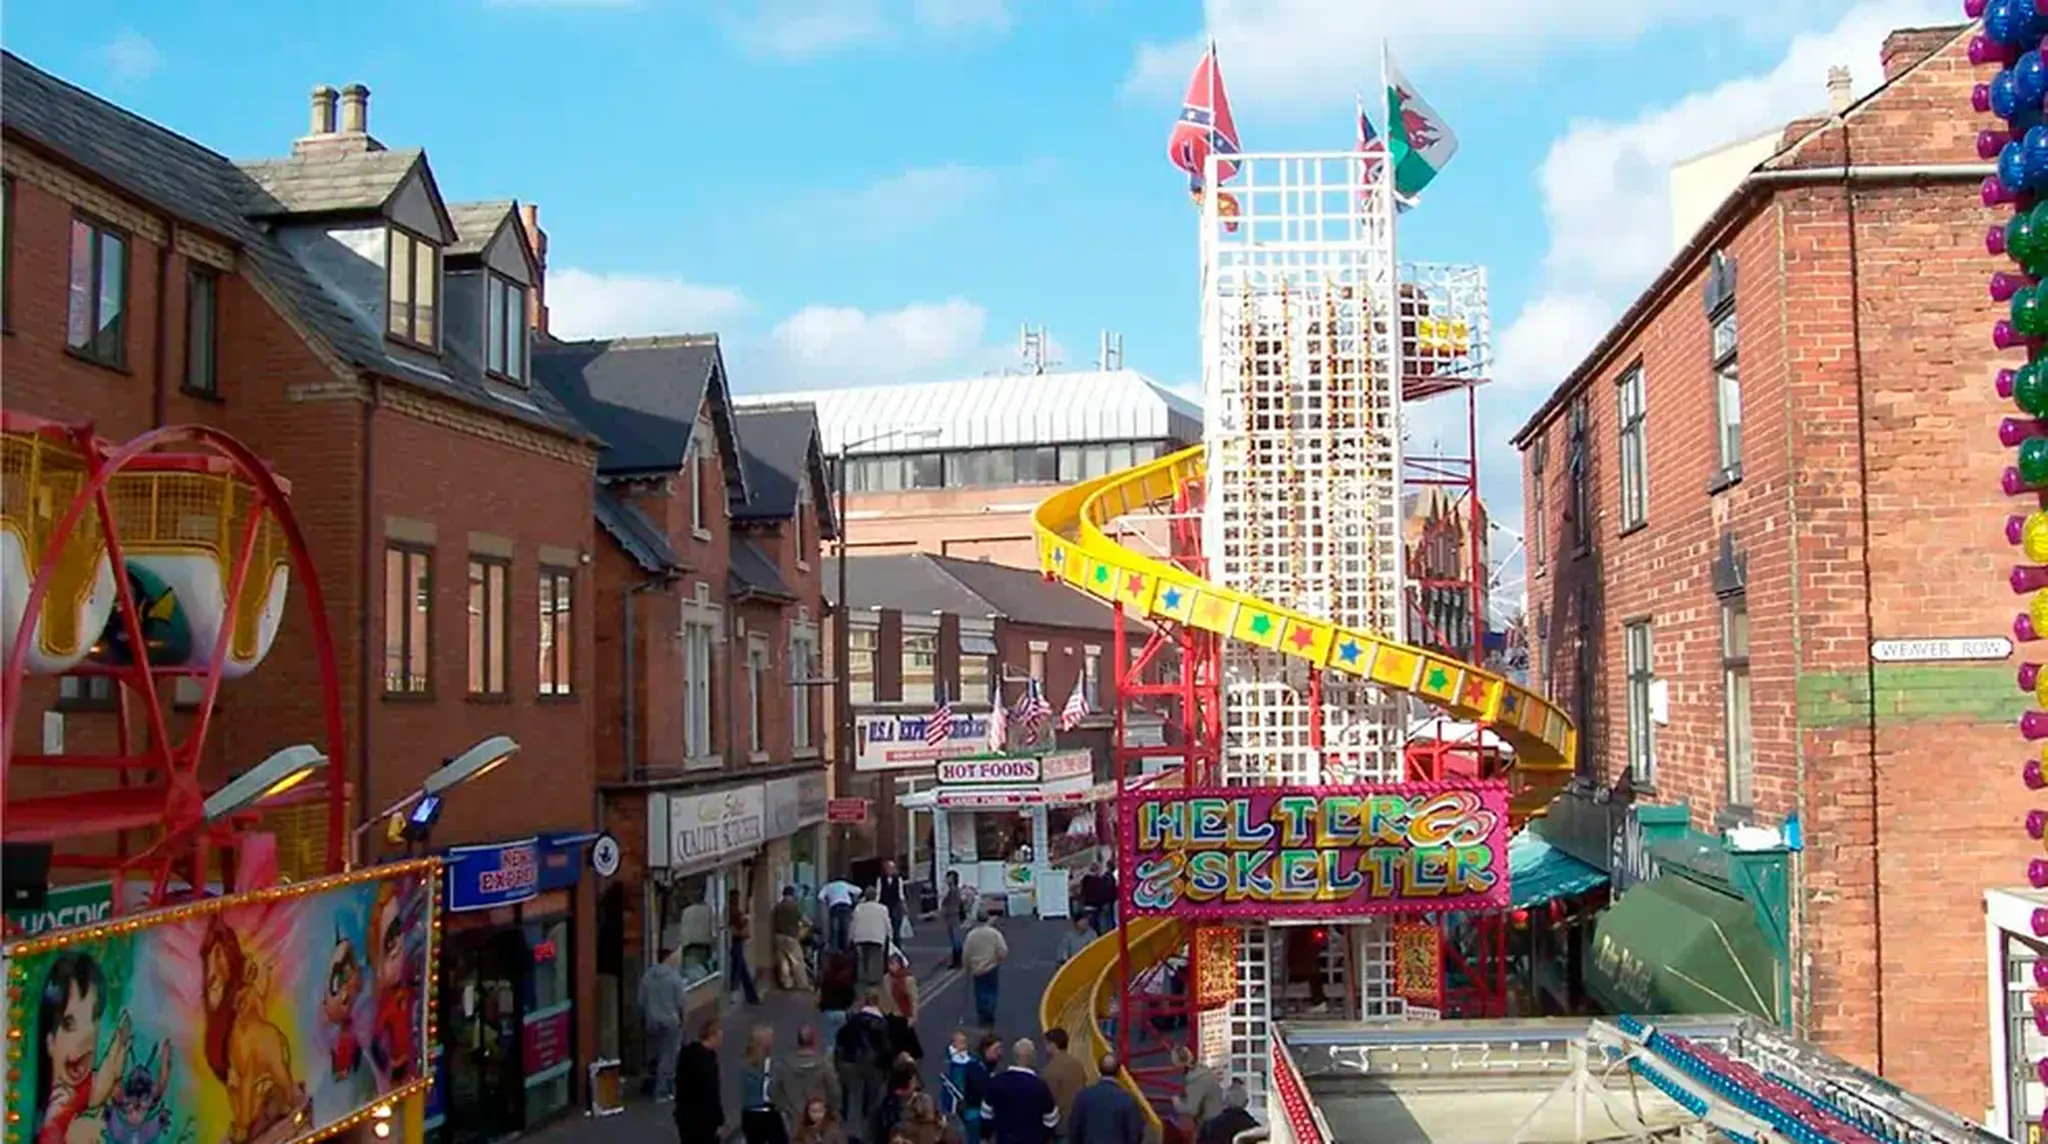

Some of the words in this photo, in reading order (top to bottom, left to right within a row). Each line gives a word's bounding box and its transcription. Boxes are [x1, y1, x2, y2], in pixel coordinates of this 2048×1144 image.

[1881, 642, 1951, 657] WEAVER
[1961, 640, 2001, 656] ROW
[943, 764, 979, 779] HOT
[980, 762, 1035, 778] FOODS
[1138, 794, 1424, 850] HELTER
[1186, 845, 1497, 901] SKELTER
